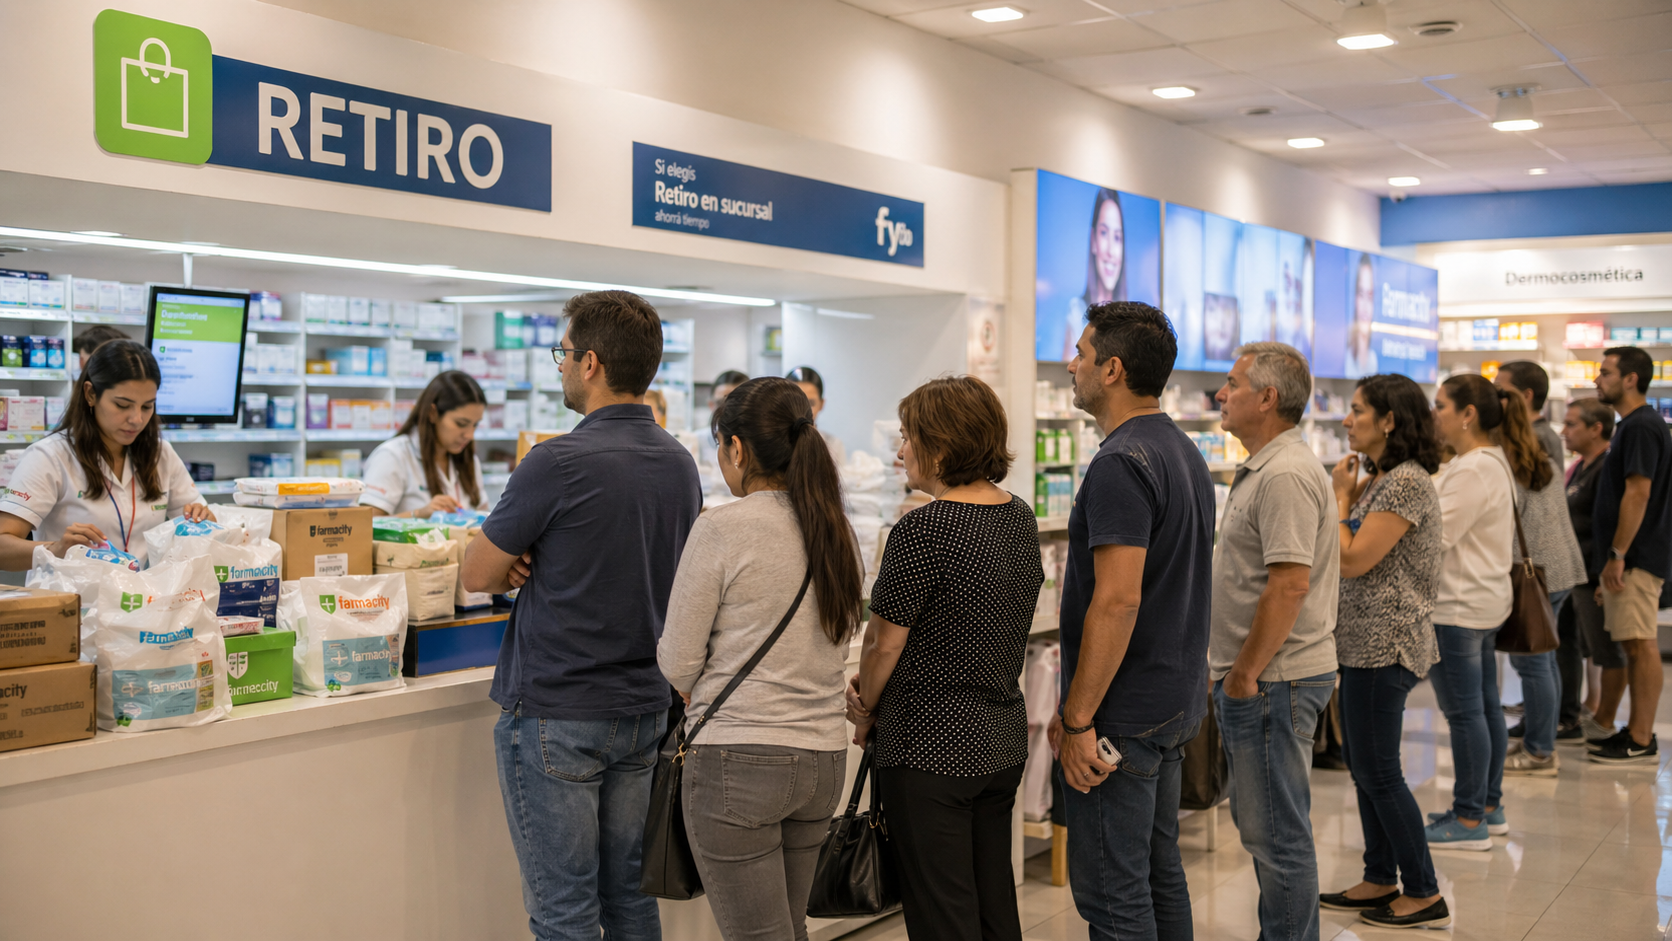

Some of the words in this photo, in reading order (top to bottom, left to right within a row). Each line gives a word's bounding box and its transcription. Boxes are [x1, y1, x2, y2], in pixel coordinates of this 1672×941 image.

[258, 81, 504, 190] RETIRO
[655, 158, 666, 175] Si
[655, 180, 699, 209] Retiro
[701, 194, 719, 212] en
[721, 198, 773, 221] sucursal
[683, 213, 711, 231] tiempo
[1505, 266, 1644, 287] Dermocosmética
[317, 524, 353, 537] farmacity
[338, 594, 390, 611] farmacity
